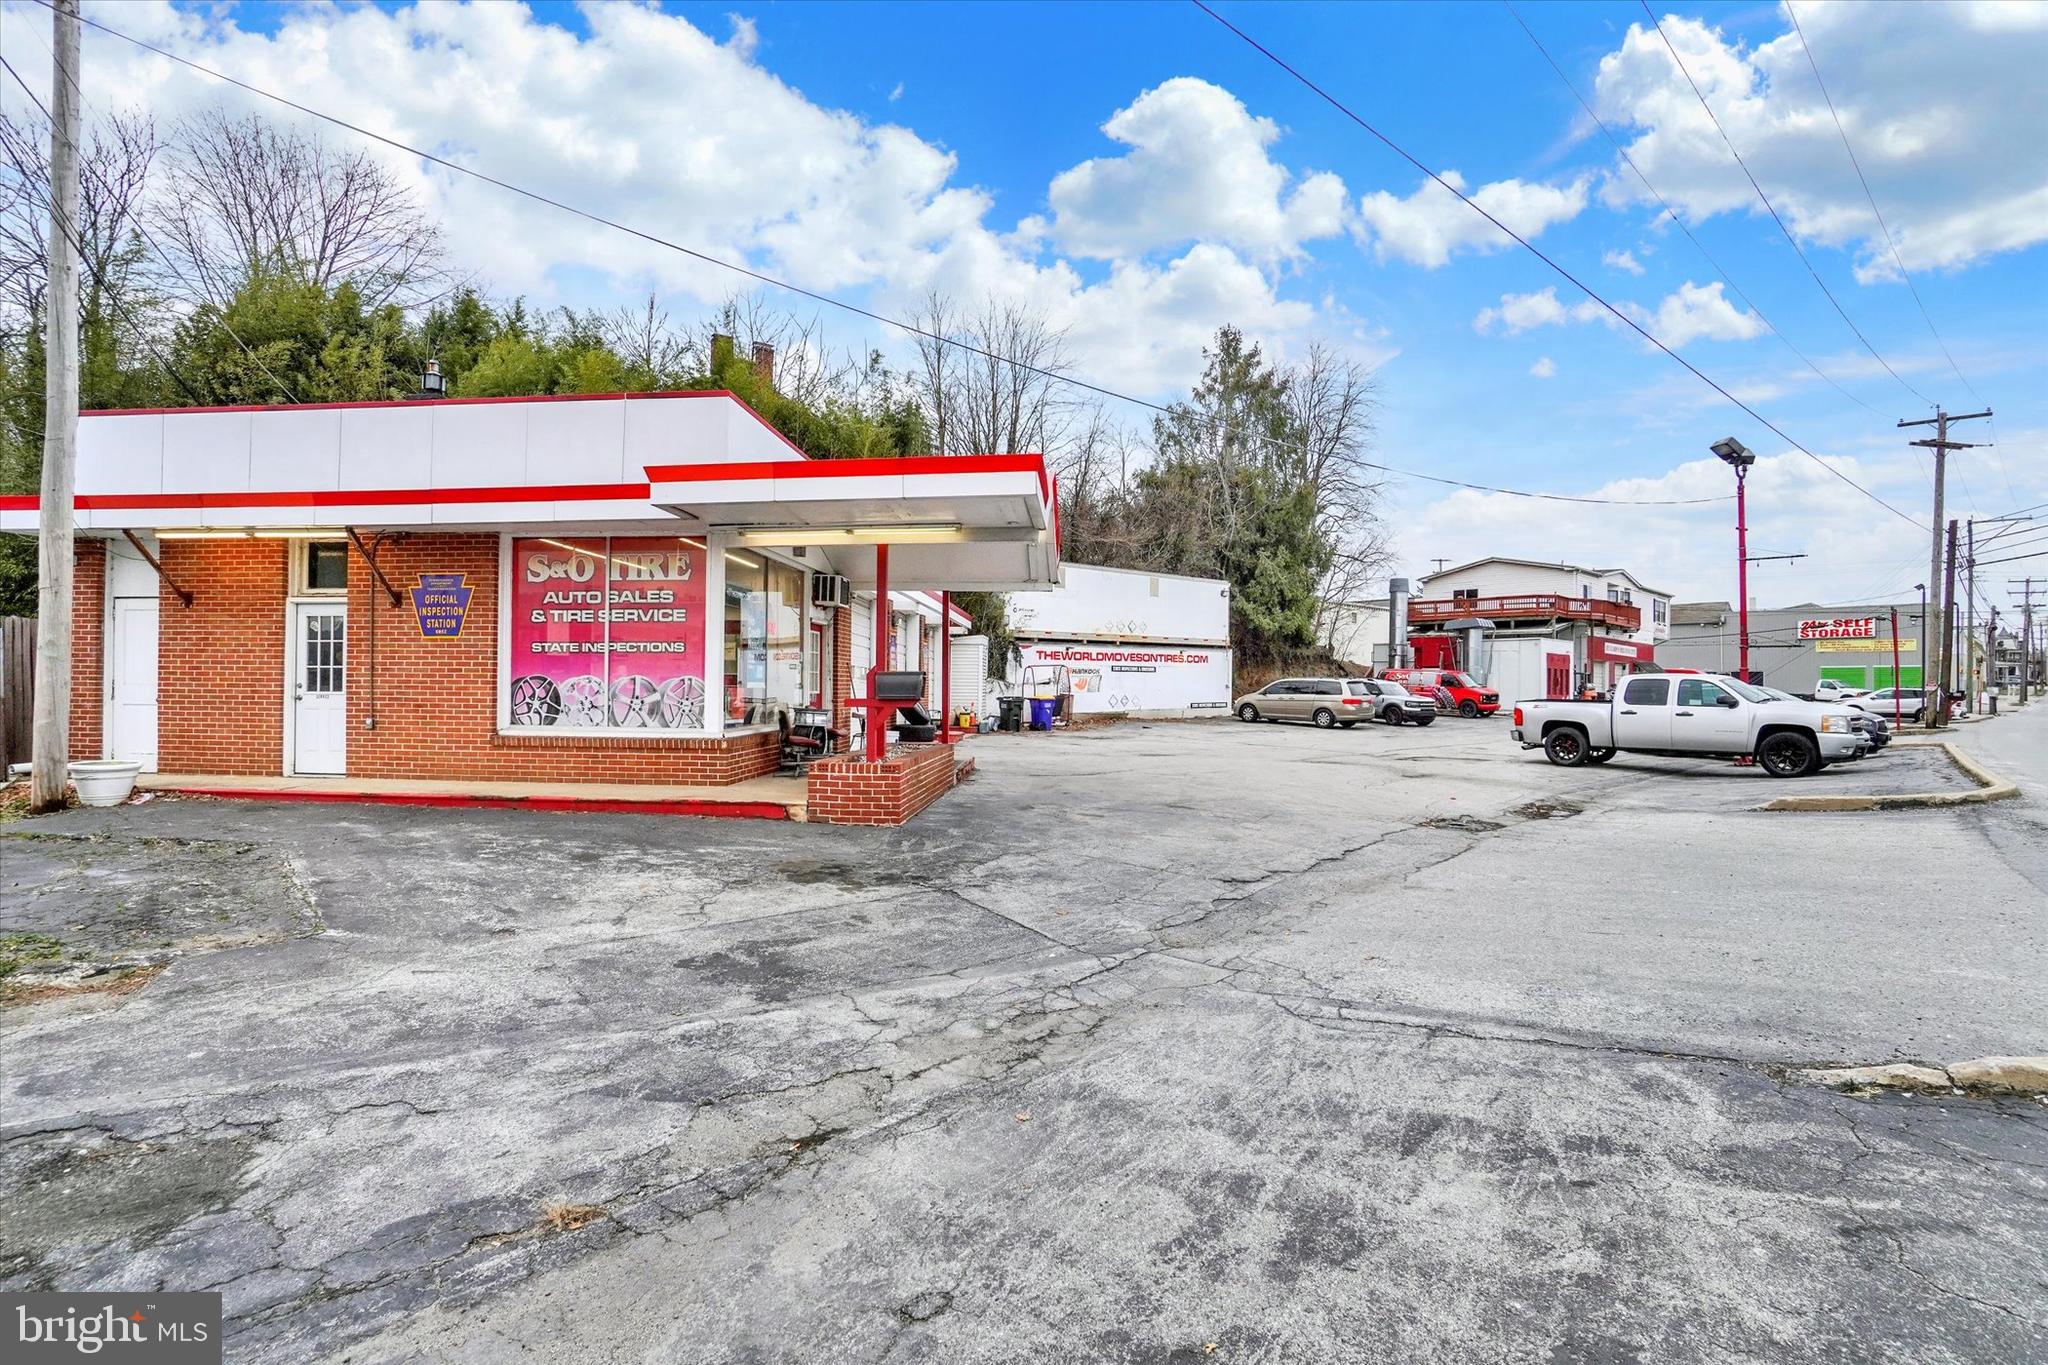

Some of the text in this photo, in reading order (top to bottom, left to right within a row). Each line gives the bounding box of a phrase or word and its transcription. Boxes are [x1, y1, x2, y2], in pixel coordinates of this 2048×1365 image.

[527, 552, 692, 583] S&O TIRE
[425, 595, 457, 604] OFFICIAL
[543, 590, 674, 604] AUTO SALES
[419, 607, 463, 616] INSPECTION
[531, 609, 686, 623] & TIRE SERVICE
[427, 619, 456, 628] STATION
[1833, 618, 1873, 628] SELF
[1800, 628, 1873, 638] STORAGE
[531, 642, 685, 653] STATE INSPECTIONS
[1036, 650, 1209, 664] THEWORLDMOVESONTIRES.COM
